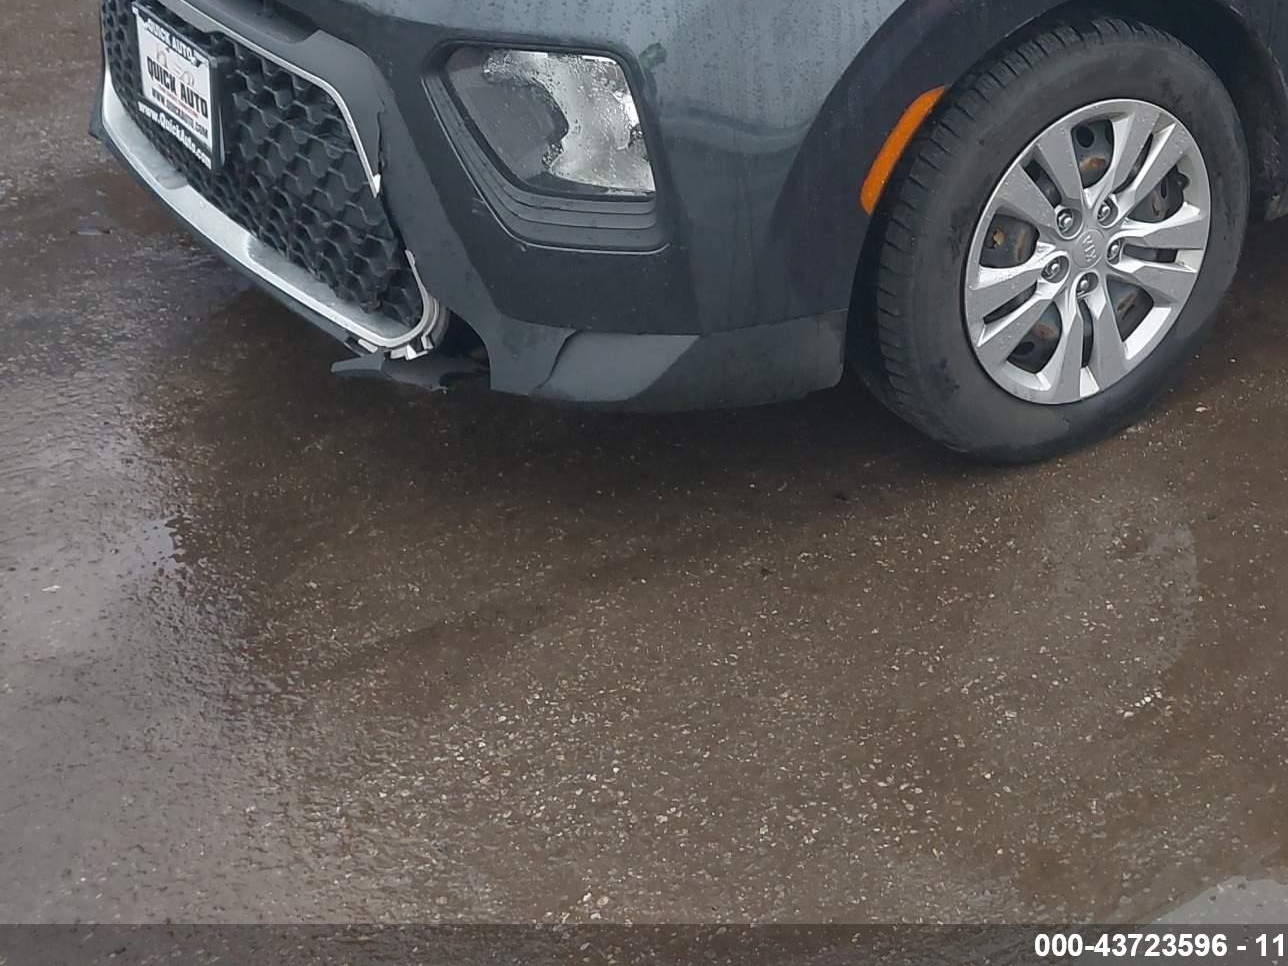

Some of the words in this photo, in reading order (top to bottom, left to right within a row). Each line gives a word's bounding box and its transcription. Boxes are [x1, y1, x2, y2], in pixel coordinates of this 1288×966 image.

[144, 17, 171, 47] QUICK
[172, 35, 194, 61] AUTO
[147, 55, 177, 96] QUICK
[180, 82, 209, 120] AUTO
[138, 100, 212, 171] www.QuickAuto.com
